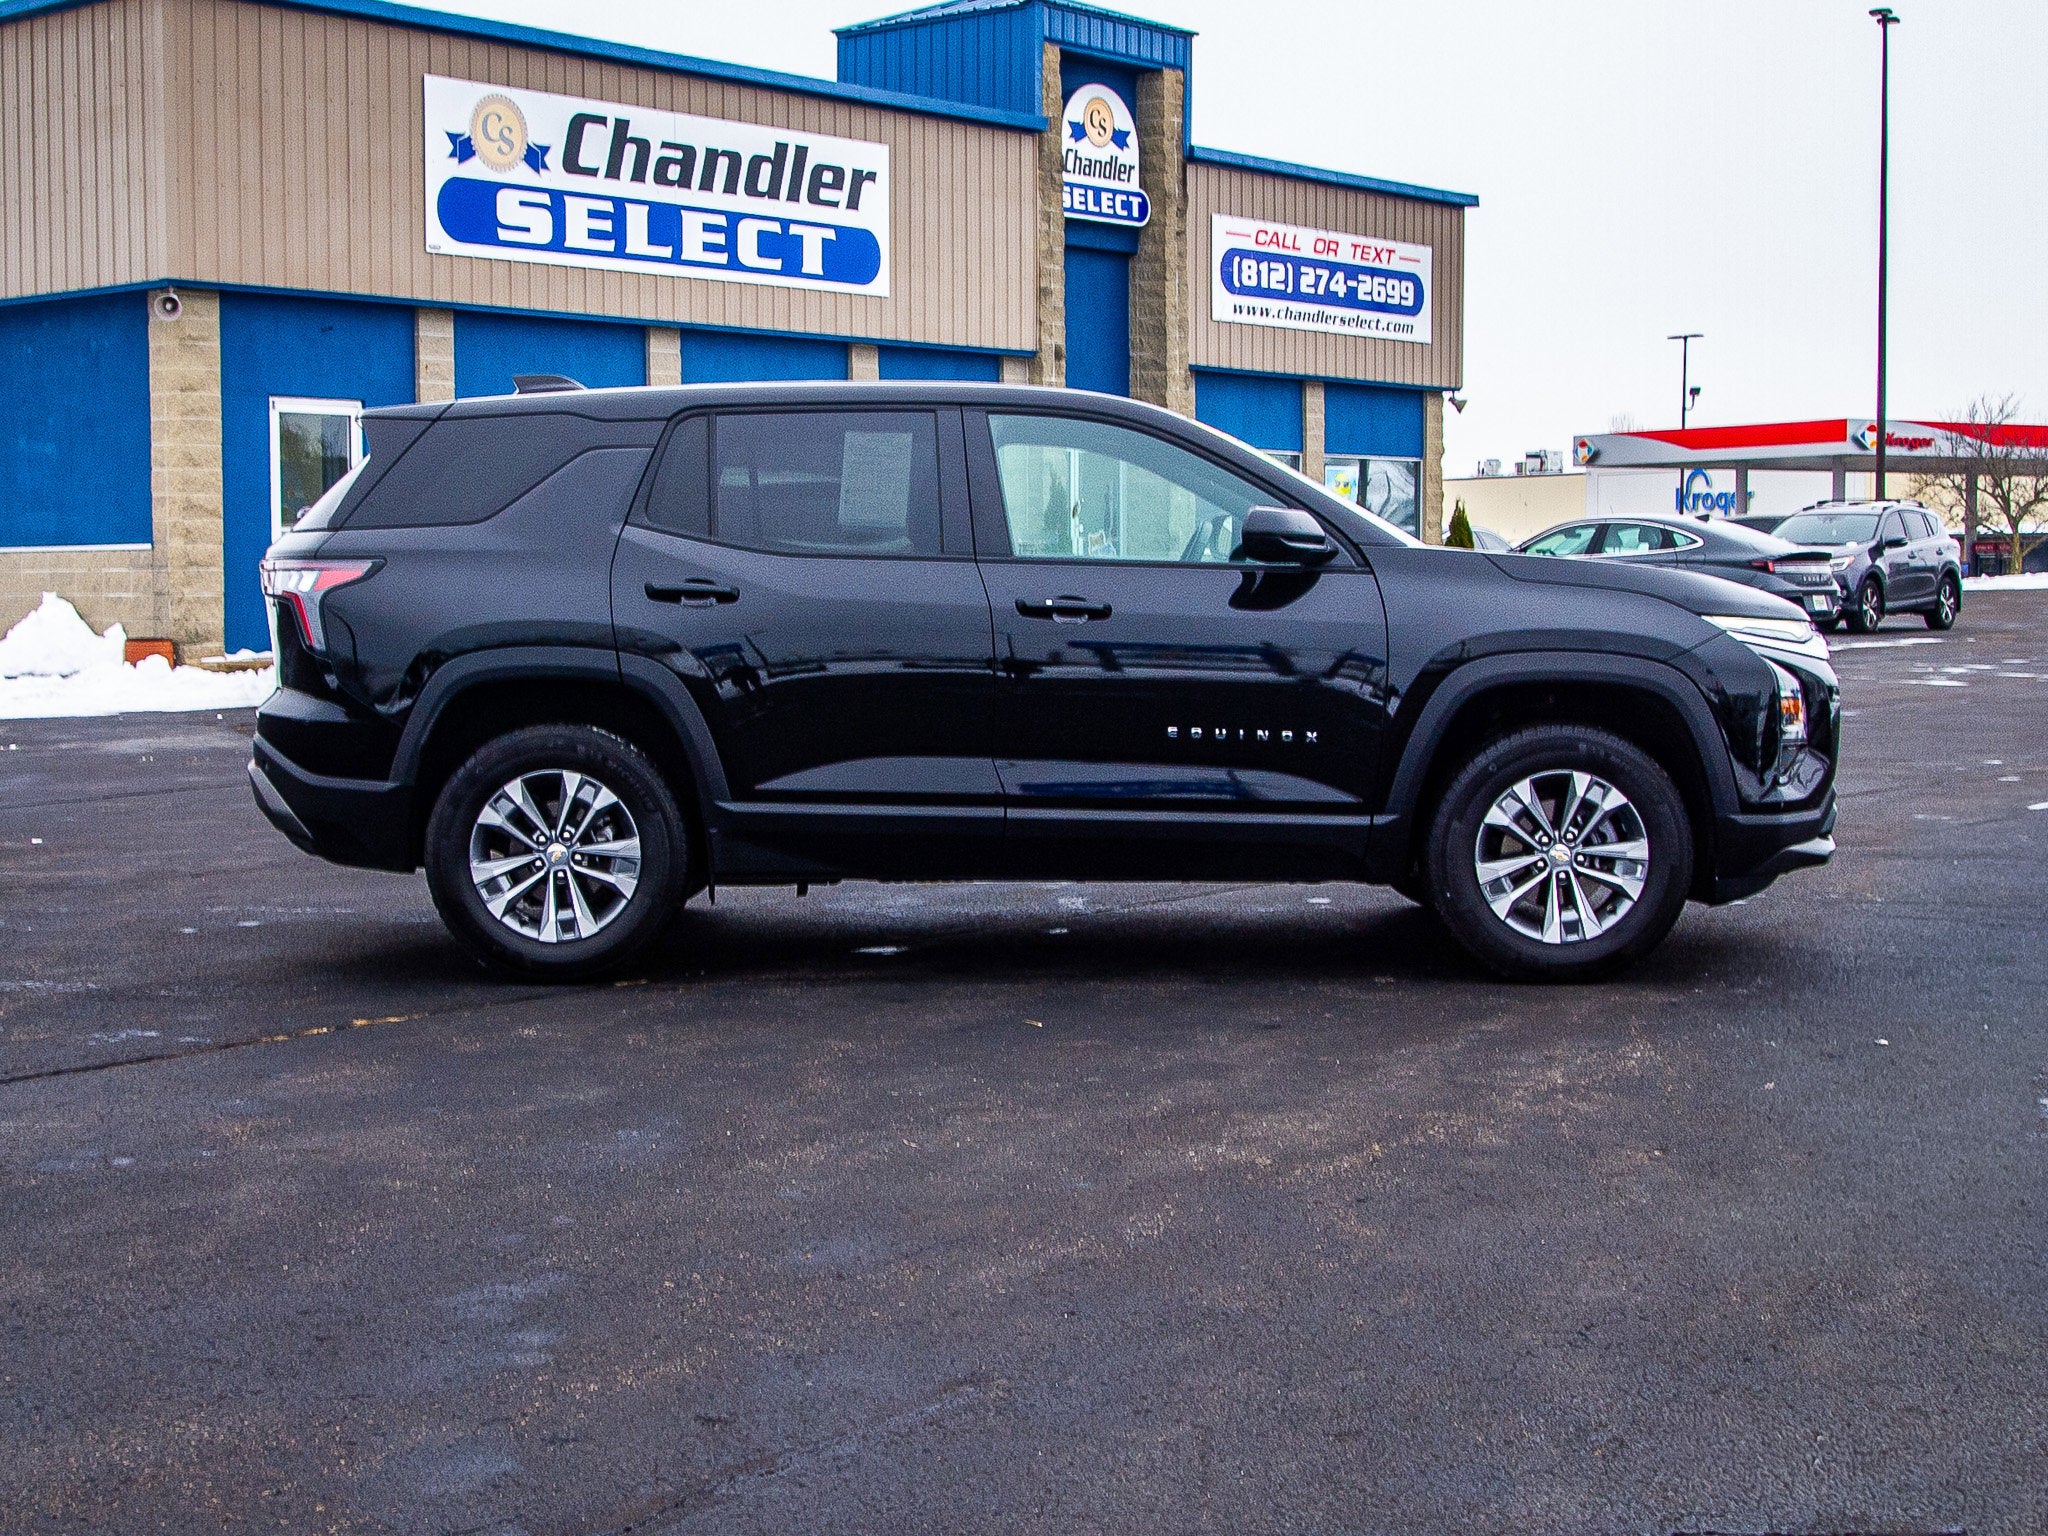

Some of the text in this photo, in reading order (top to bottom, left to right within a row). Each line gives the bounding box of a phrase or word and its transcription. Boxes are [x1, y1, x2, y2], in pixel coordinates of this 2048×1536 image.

[562, 112, 877, 211] Chandler
[1064, 149, 1135, 183] Chandler
[496, 188, 837, 276] SELECT
[1255, 229, 1396, 265] CALL OR TEXT
[1232, 255, 1415, 307] (812) 274-2699
[1233, 303, 1415, 335] www.chandlerselect.com
[1885, 432, 1935, 451] Kroger
[1167, 726, 1318, 743] EQUINOX
